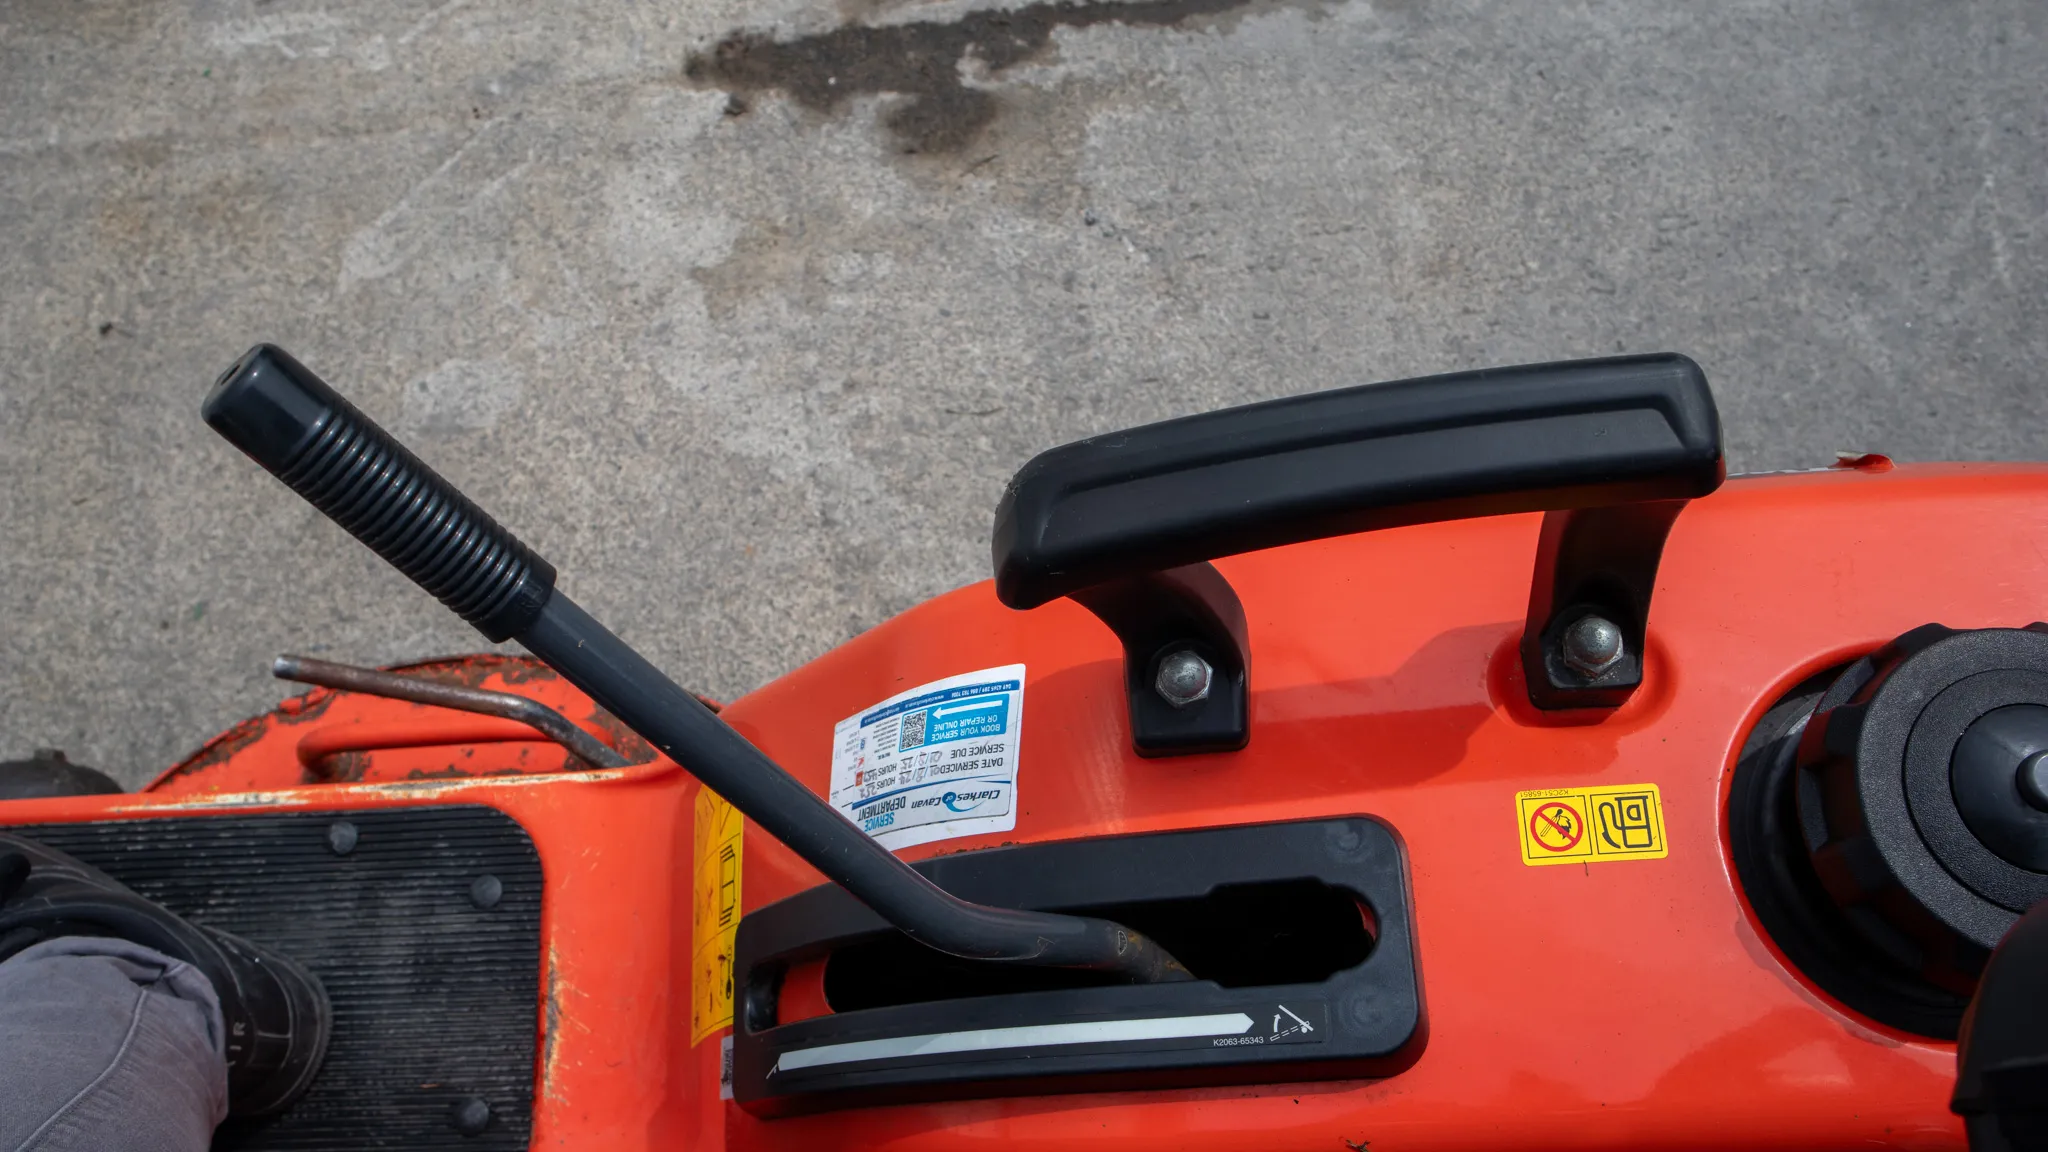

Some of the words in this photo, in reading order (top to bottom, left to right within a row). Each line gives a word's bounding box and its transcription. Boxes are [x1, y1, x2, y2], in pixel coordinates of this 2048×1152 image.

[959, 716, 985, 727] REPAIR
[988, 714, 998, 723] OR
[934, 720, 958, 731] ONLINE
[960, 726, 979, 737] YOUR
[980, 723, 1000, 734] BOOK
[931, 729, 958, 742] SERVICE
[950, 747, 967, 759] DUE
[968, 743, 1004, 757] SERVICE
[878, 763, 897, 776] HOURS
[940, 760, 979, 774] SERVICED
[981, 757, 1003, 769] DATE
[877, 776, 896, 790] HOURS
[957, 789, 1001, 802] Clarkes
[857, 796, 906, 822] DEPARTMENT
[911, 796, 942, 809] Cavan
[864, 811, 895, 832] SERVICE
[1213, 1036, 1264, 1046] K2063-65343
